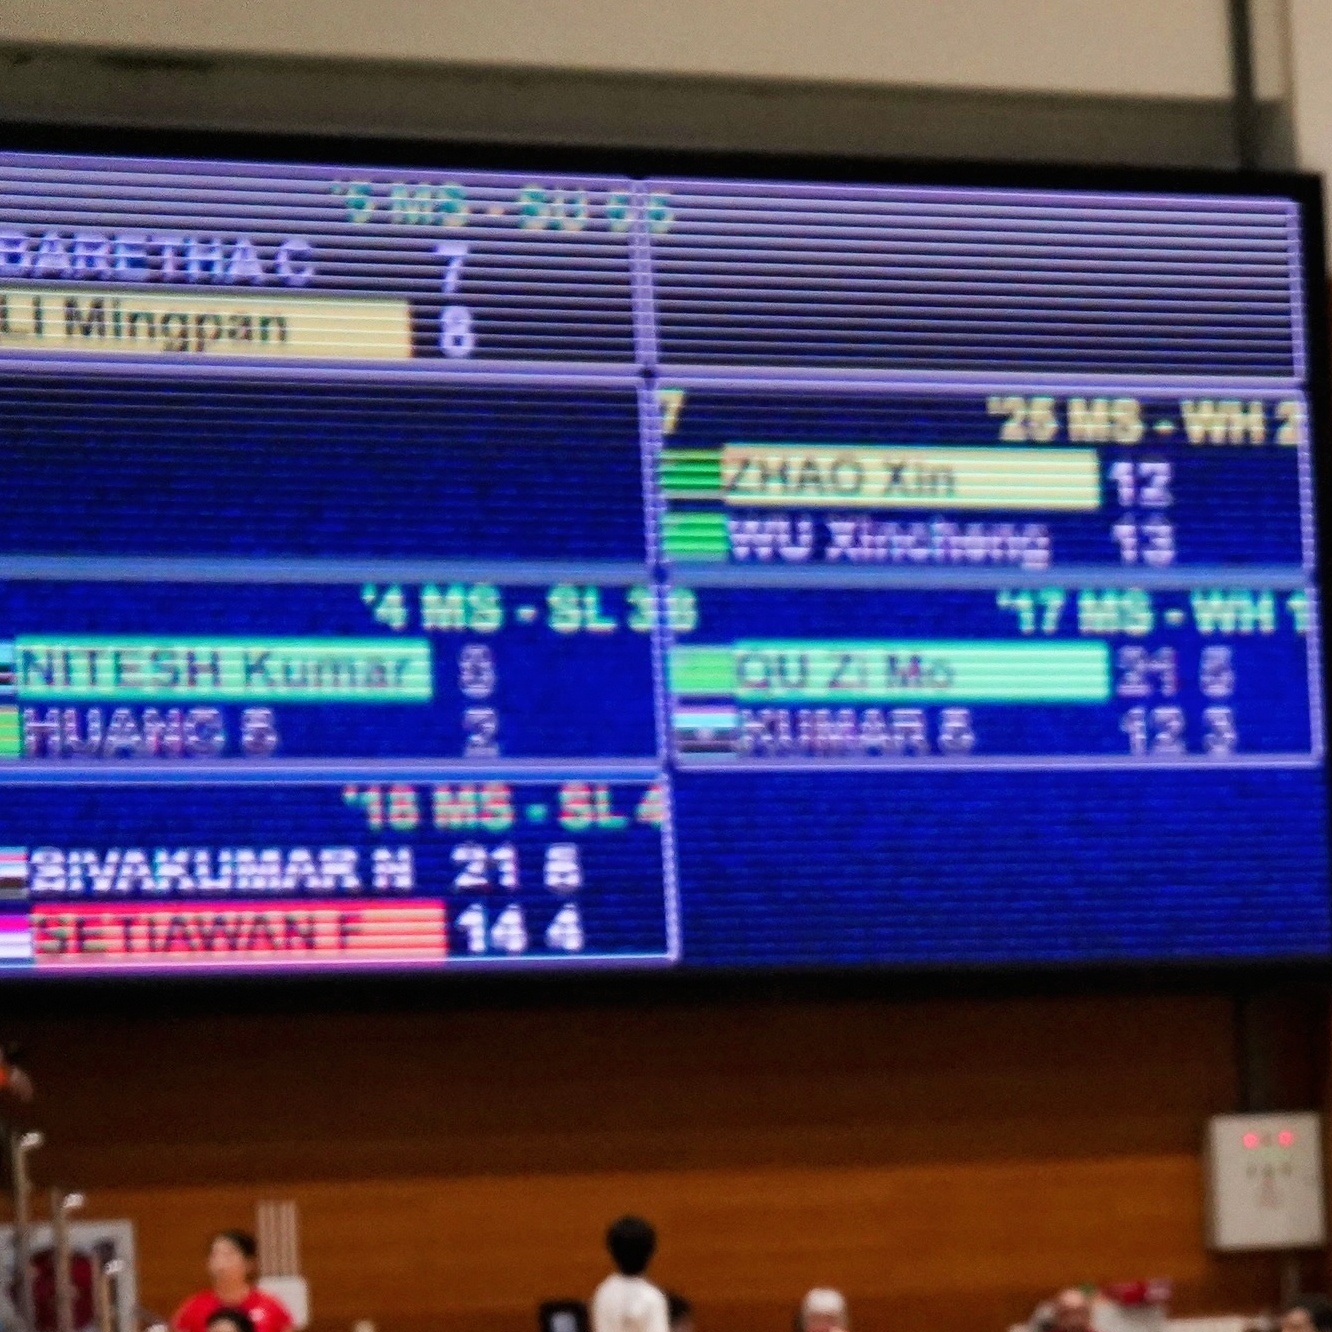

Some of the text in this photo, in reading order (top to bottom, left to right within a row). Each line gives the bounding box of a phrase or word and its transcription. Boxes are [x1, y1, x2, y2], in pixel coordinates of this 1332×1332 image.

[64, 296, 288, 352] Mingpan
[420, 582, 505, 634] MS
[546, 582, 619, 634] SL
[1078, 586, 1156, 637] MS
[21, 647, 413, 690] NITESH Kumar
[432, 782, 516, 833] MS
[451, 841, 520, 894] 21
[35, 911, 316, 956] SETIAWAN
[455, 902, 586, 954] 14 4
